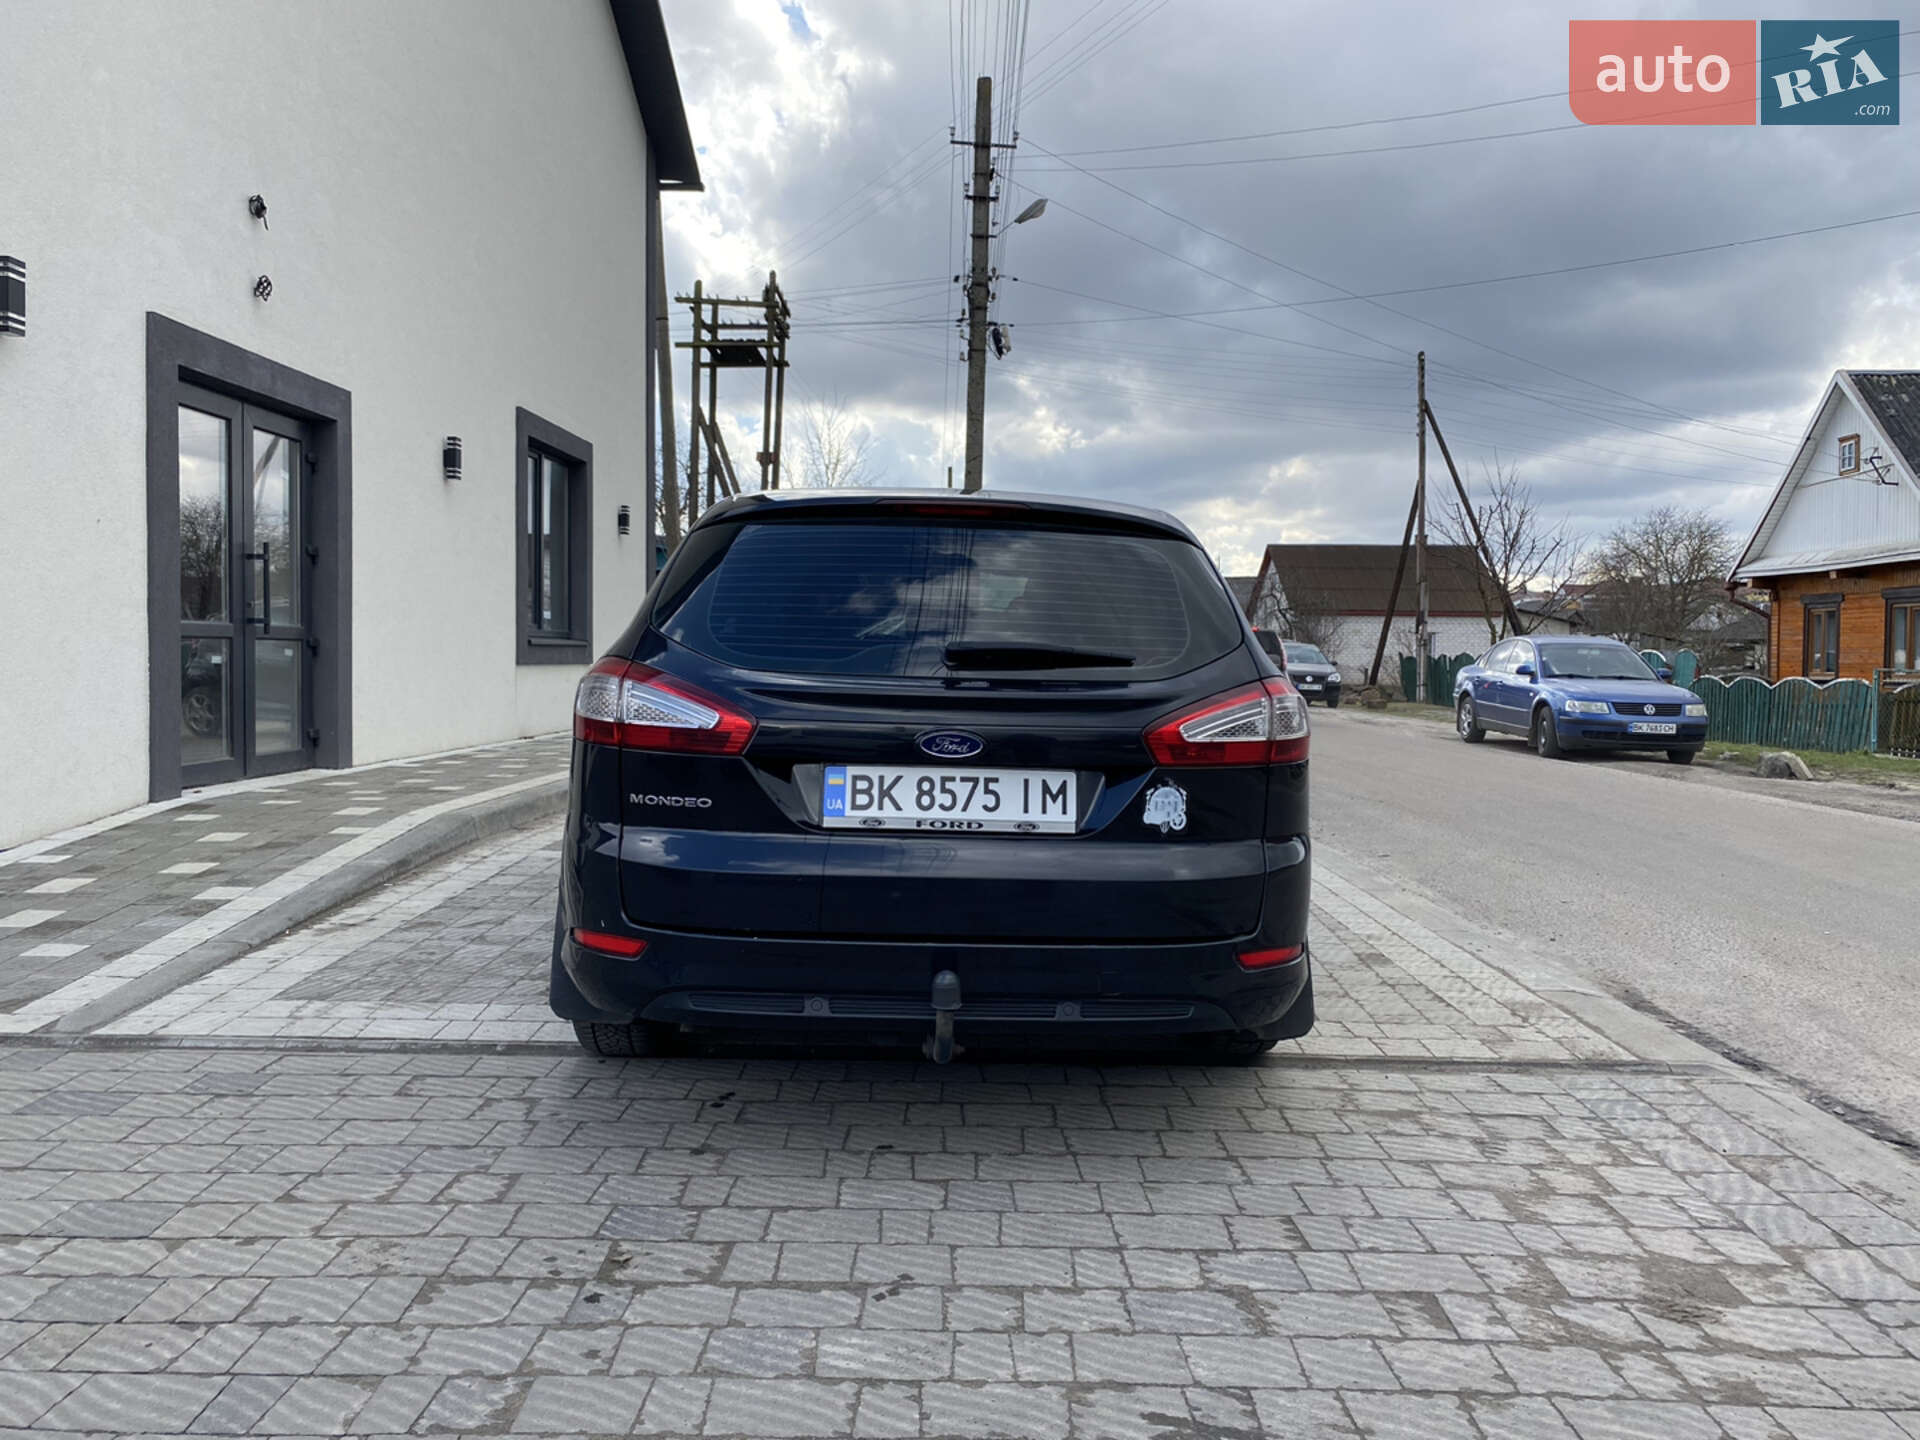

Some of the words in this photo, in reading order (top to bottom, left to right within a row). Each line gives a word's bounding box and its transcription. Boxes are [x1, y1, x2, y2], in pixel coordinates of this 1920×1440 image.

[932, 736, 970, 753] Ford
[629, 793, 713, 808] MONDEO
[850, 774, 904, 811] BK
[915, 775, 1001, 812] 8575
[1022, 778, 1068, 815] IM
[827, 798, 843, 809] UA
[915, 819, 984, 830] FORD
